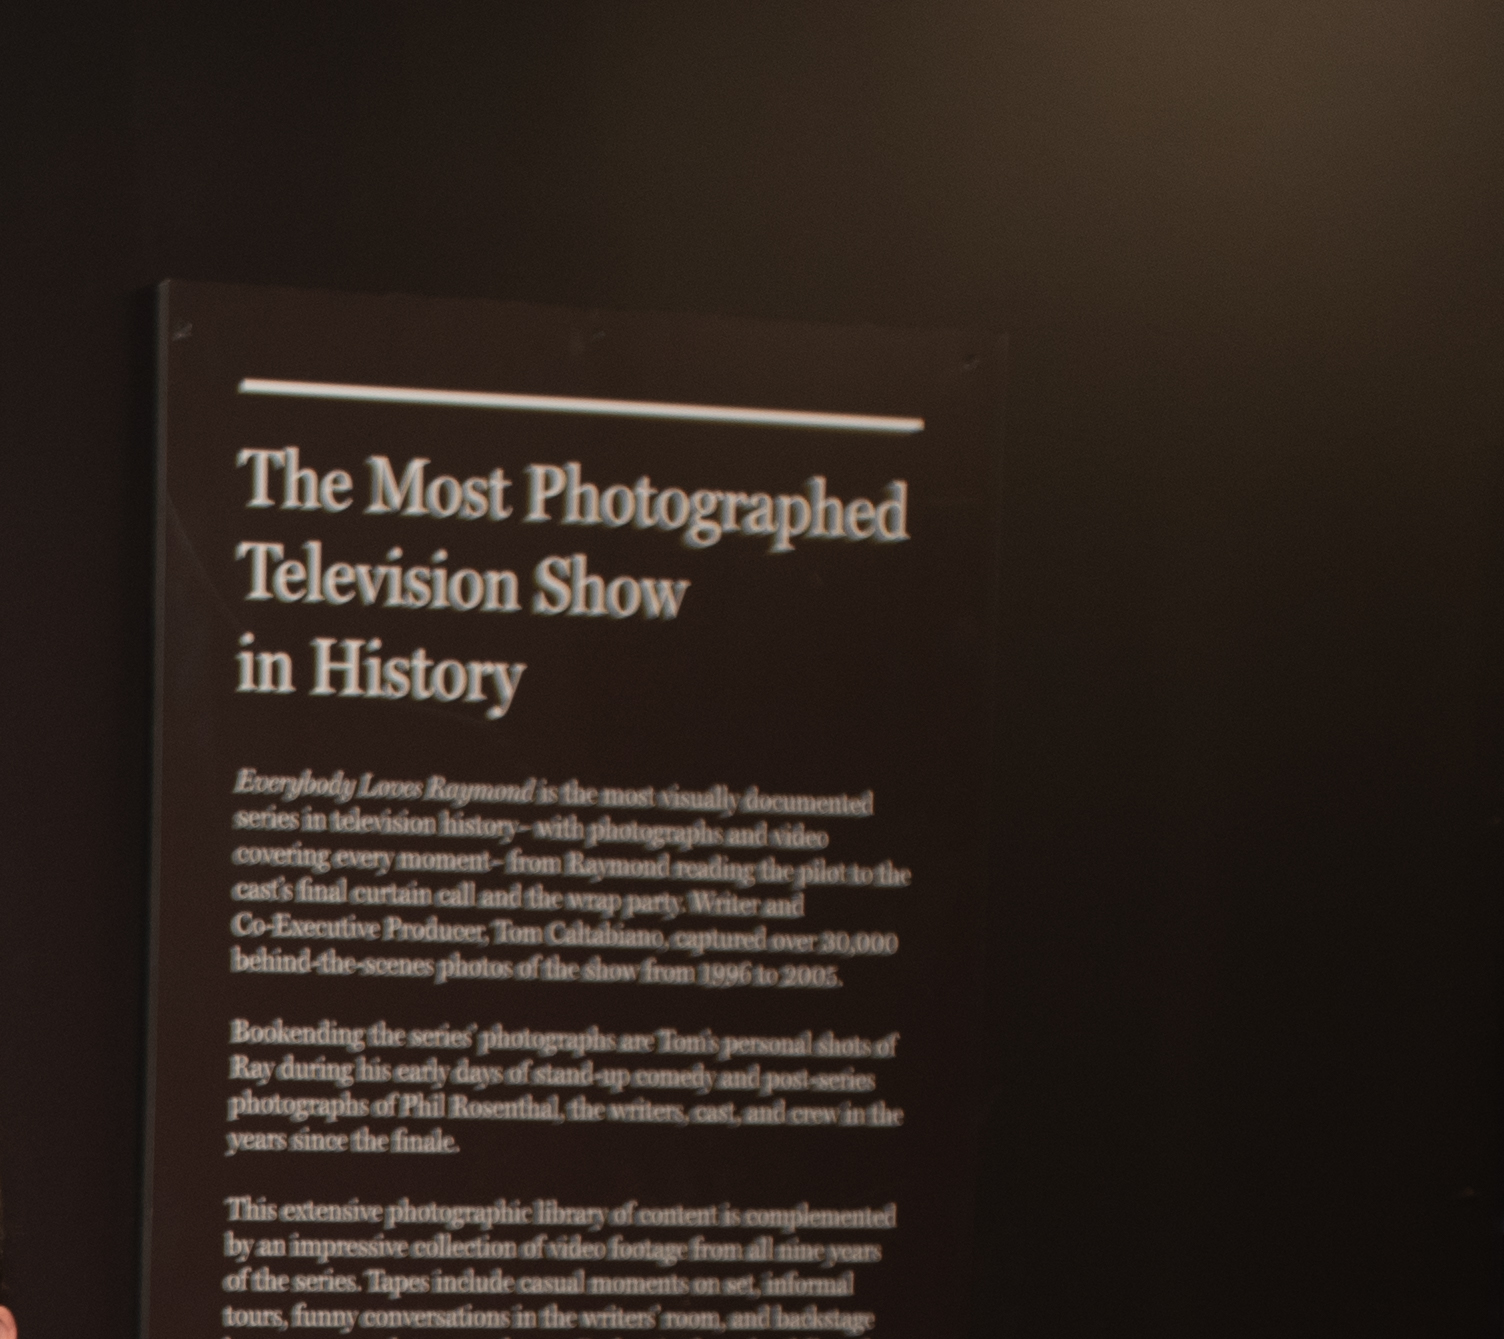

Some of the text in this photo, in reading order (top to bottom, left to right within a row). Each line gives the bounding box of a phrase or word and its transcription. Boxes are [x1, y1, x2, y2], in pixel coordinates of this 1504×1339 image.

[237, 446, 908, 552] The Most Photographed
[236, 539, 689, 618] Television Show
[238, 632, 526, 719] in History
[234, 767, 873, 816] Everybody Loves Raymond is the most visually documented
[295, 875, 348, 904] final
[349, 881, 433, 906] curtain
[434, 881, 476, 907] call
[476, 882, 522, 909] and
[523, 884, 563, 910] the
[563, 893, 622, 919] wrap
[622, 893, 685, 918] party.
[688, 890, 758, 916] Writer
[758, 892, 804, 918] and
[231, 911, 898, 955] Co-Executive Producer, Tom Caltabiano, captured over 30,000
[231, 945, 842, 987] behind-the-scenes photos of the show from 1996 to 2005.
[230, 1017, 366, 1053] Bookending
[366, 1019, 406, 1047] the
[477, 1023, 617, 1057] photographs
[617, 1034, 654, 1053] are
[719, 1031, 812, 1059] personal
[814, 1031, 872, 1057] shots
[872, 1033, 899, 1057] of
[226, 1126, 459, 1156] years since the finale.
[225, 1196, 896, 1233] This extensive photographic library of content is complemented
